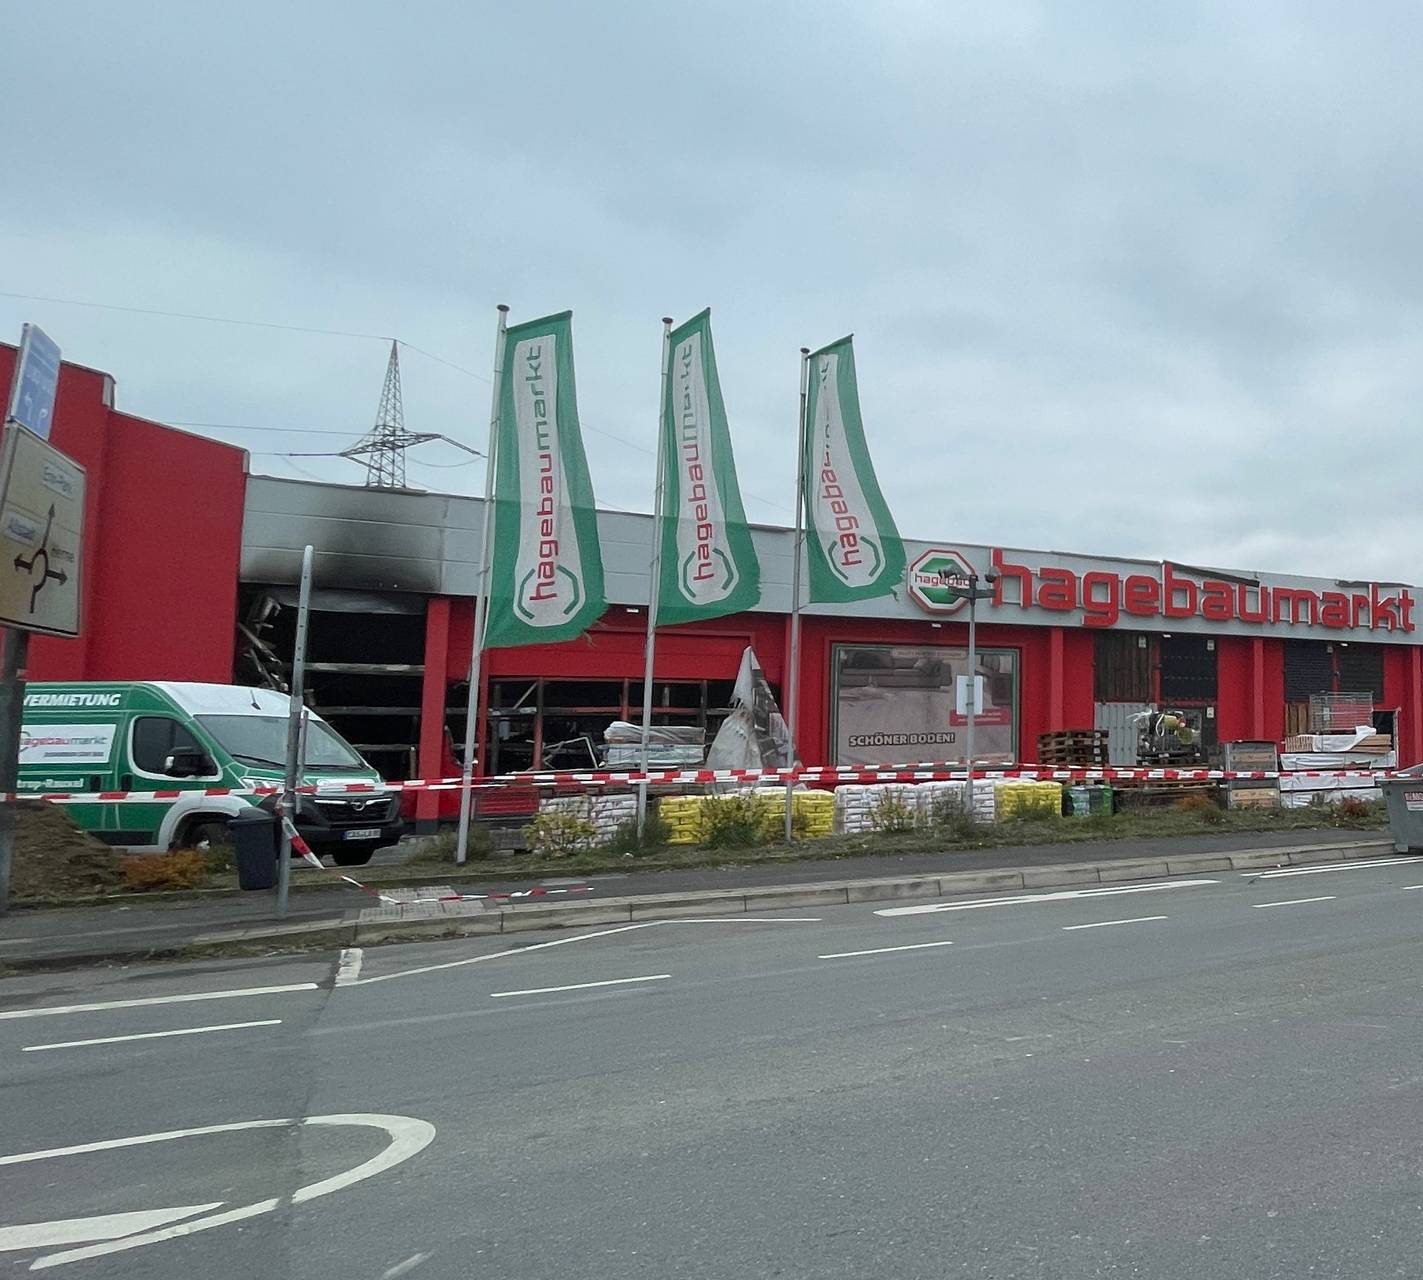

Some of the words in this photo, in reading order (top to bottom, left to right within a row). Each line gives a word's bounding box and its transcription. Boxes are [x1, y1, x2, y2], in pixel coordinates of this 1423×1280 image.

[525, 344, 559, 602] hagebaumarkt
[680, 343, 715, 582] hagebaumakt
[991, 548, 1416, 632] hagebaumarkt
[849, 732, 908, 747] SCHÖNER
[909, 732, 956, 744] BODEN!
